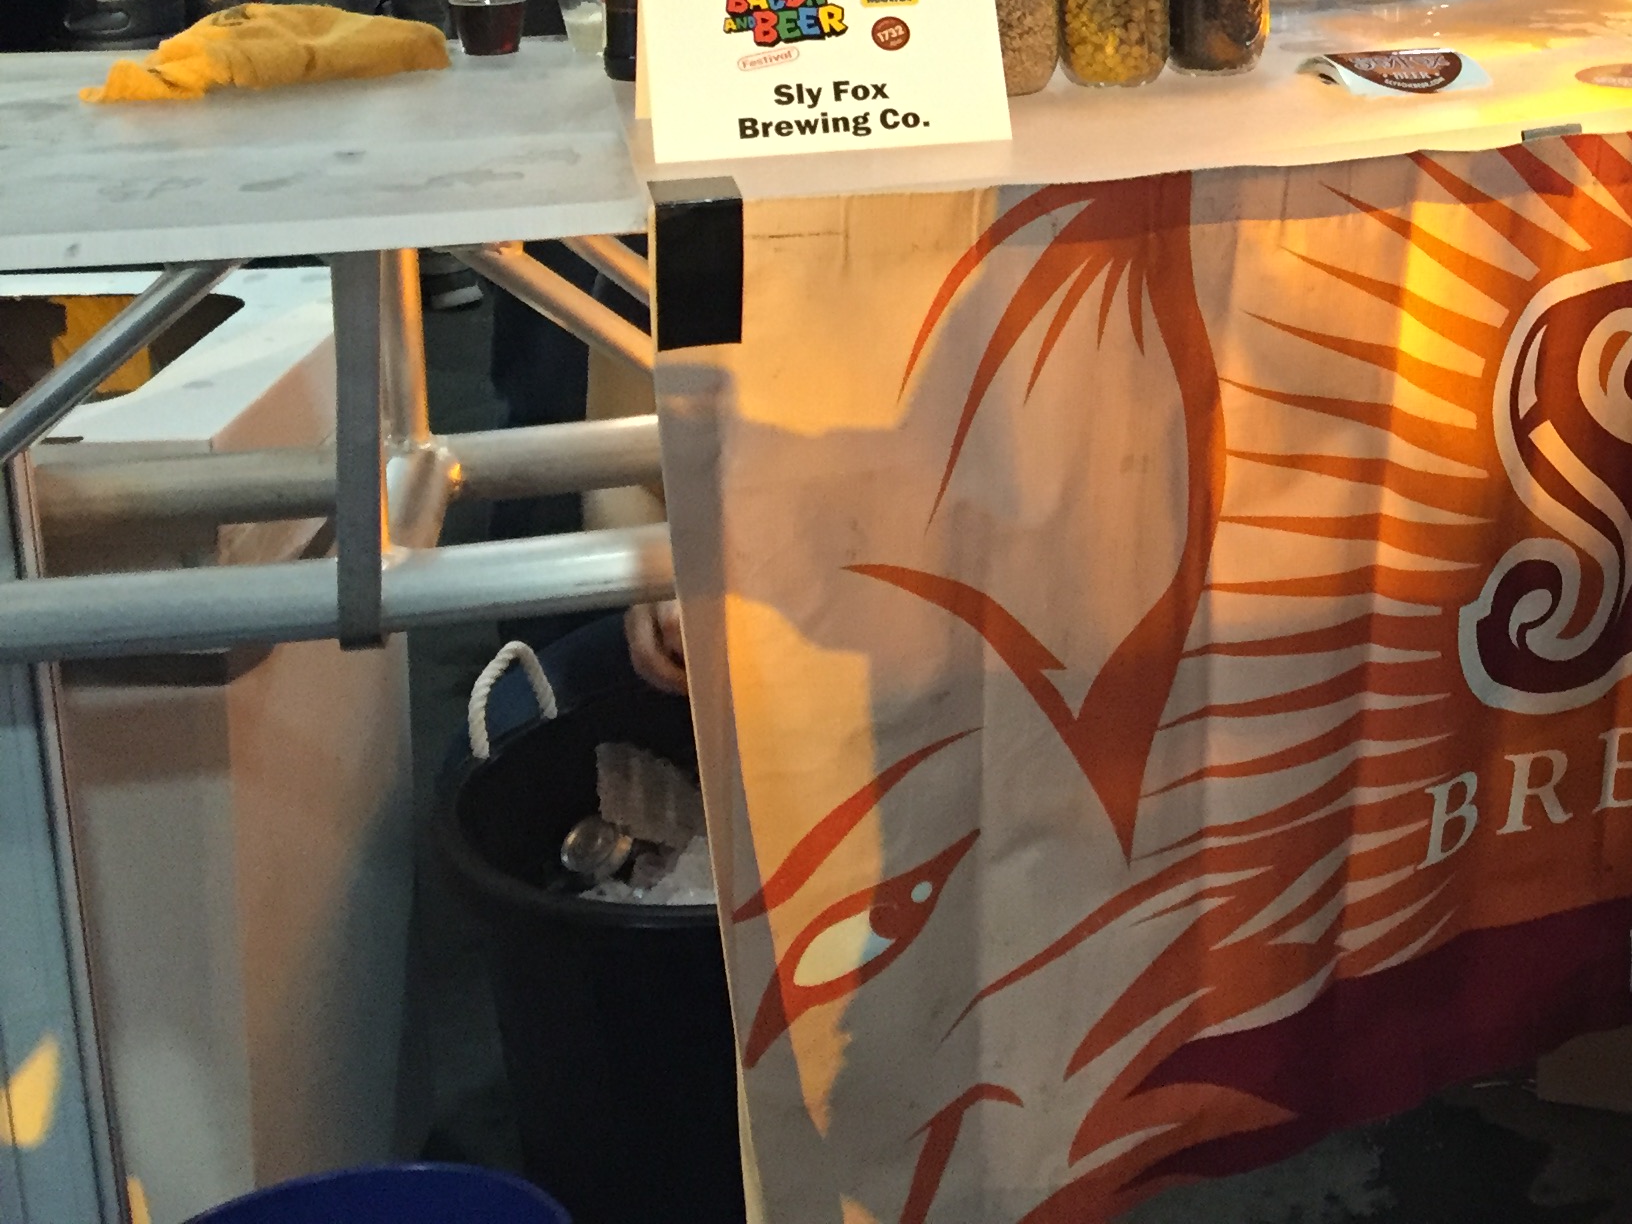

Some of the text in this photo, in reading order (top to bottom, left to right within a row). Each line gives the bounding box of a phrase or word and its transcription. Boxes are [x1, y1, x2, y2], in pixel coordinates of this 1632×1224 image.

[723, 2, 849, 48] AND BEER
[877, 25, 905, 42] 1732
[741, 49, 793, 69] Festival
[773, 80, 890, 109] Sly Fox
[738, 108, 931, 140] Brewing Co.
